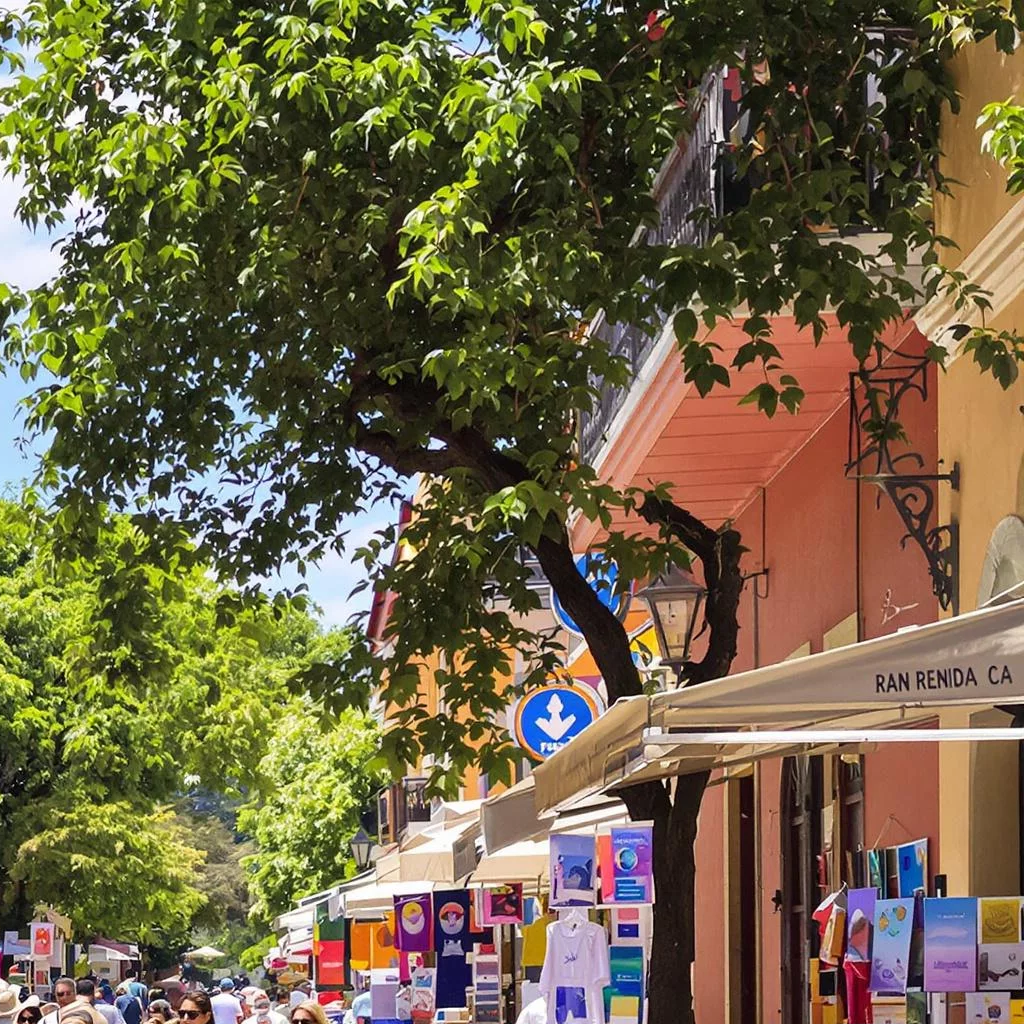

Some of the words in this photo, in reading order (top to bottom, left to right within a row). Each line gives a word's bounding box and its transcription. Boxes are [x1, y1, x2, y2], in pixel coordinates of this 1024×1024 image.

[875, 671, 910, 693] RAN
[916, 667, 978, 690] RENIDA
[988, 665, 1013, 685] CA
